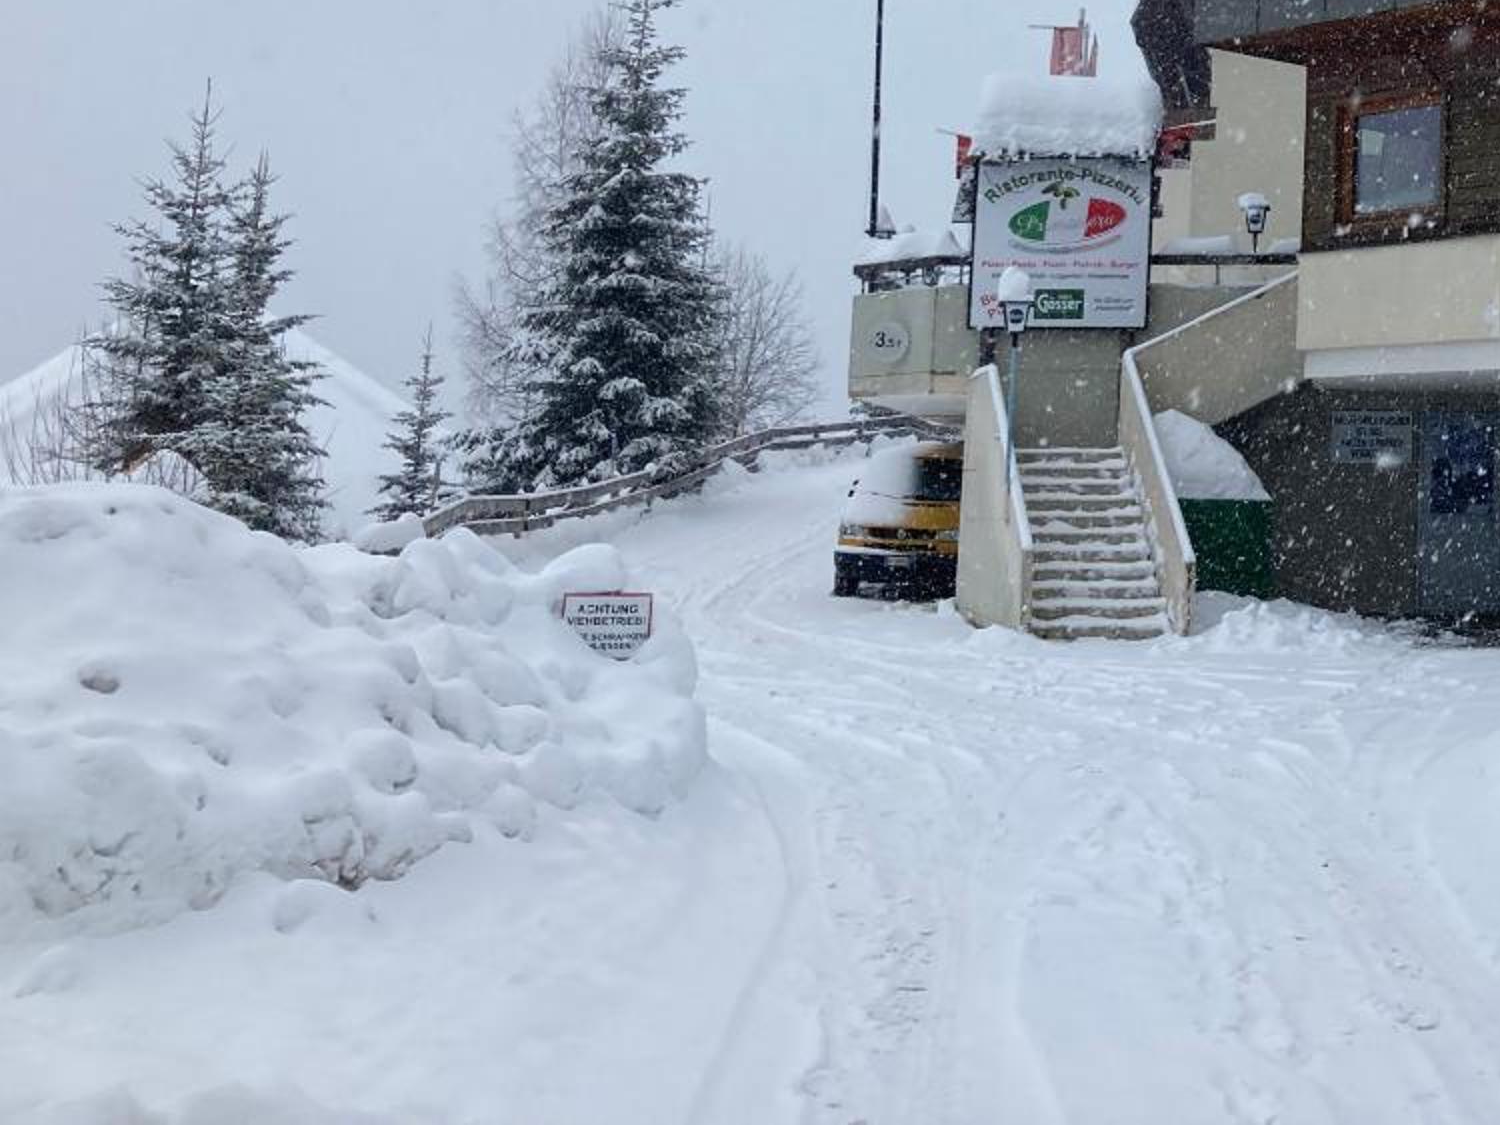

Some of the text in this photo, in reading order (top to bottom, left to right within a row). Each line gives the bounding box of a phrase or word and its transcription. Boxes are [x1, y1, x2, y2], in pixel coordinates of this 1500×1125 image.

[983, 167, 1148, 205] Ristorante-Pizzeria
[1037, 293, 1082, 313] Gösser
[577, 604, 639, 614] ACHTUNG
